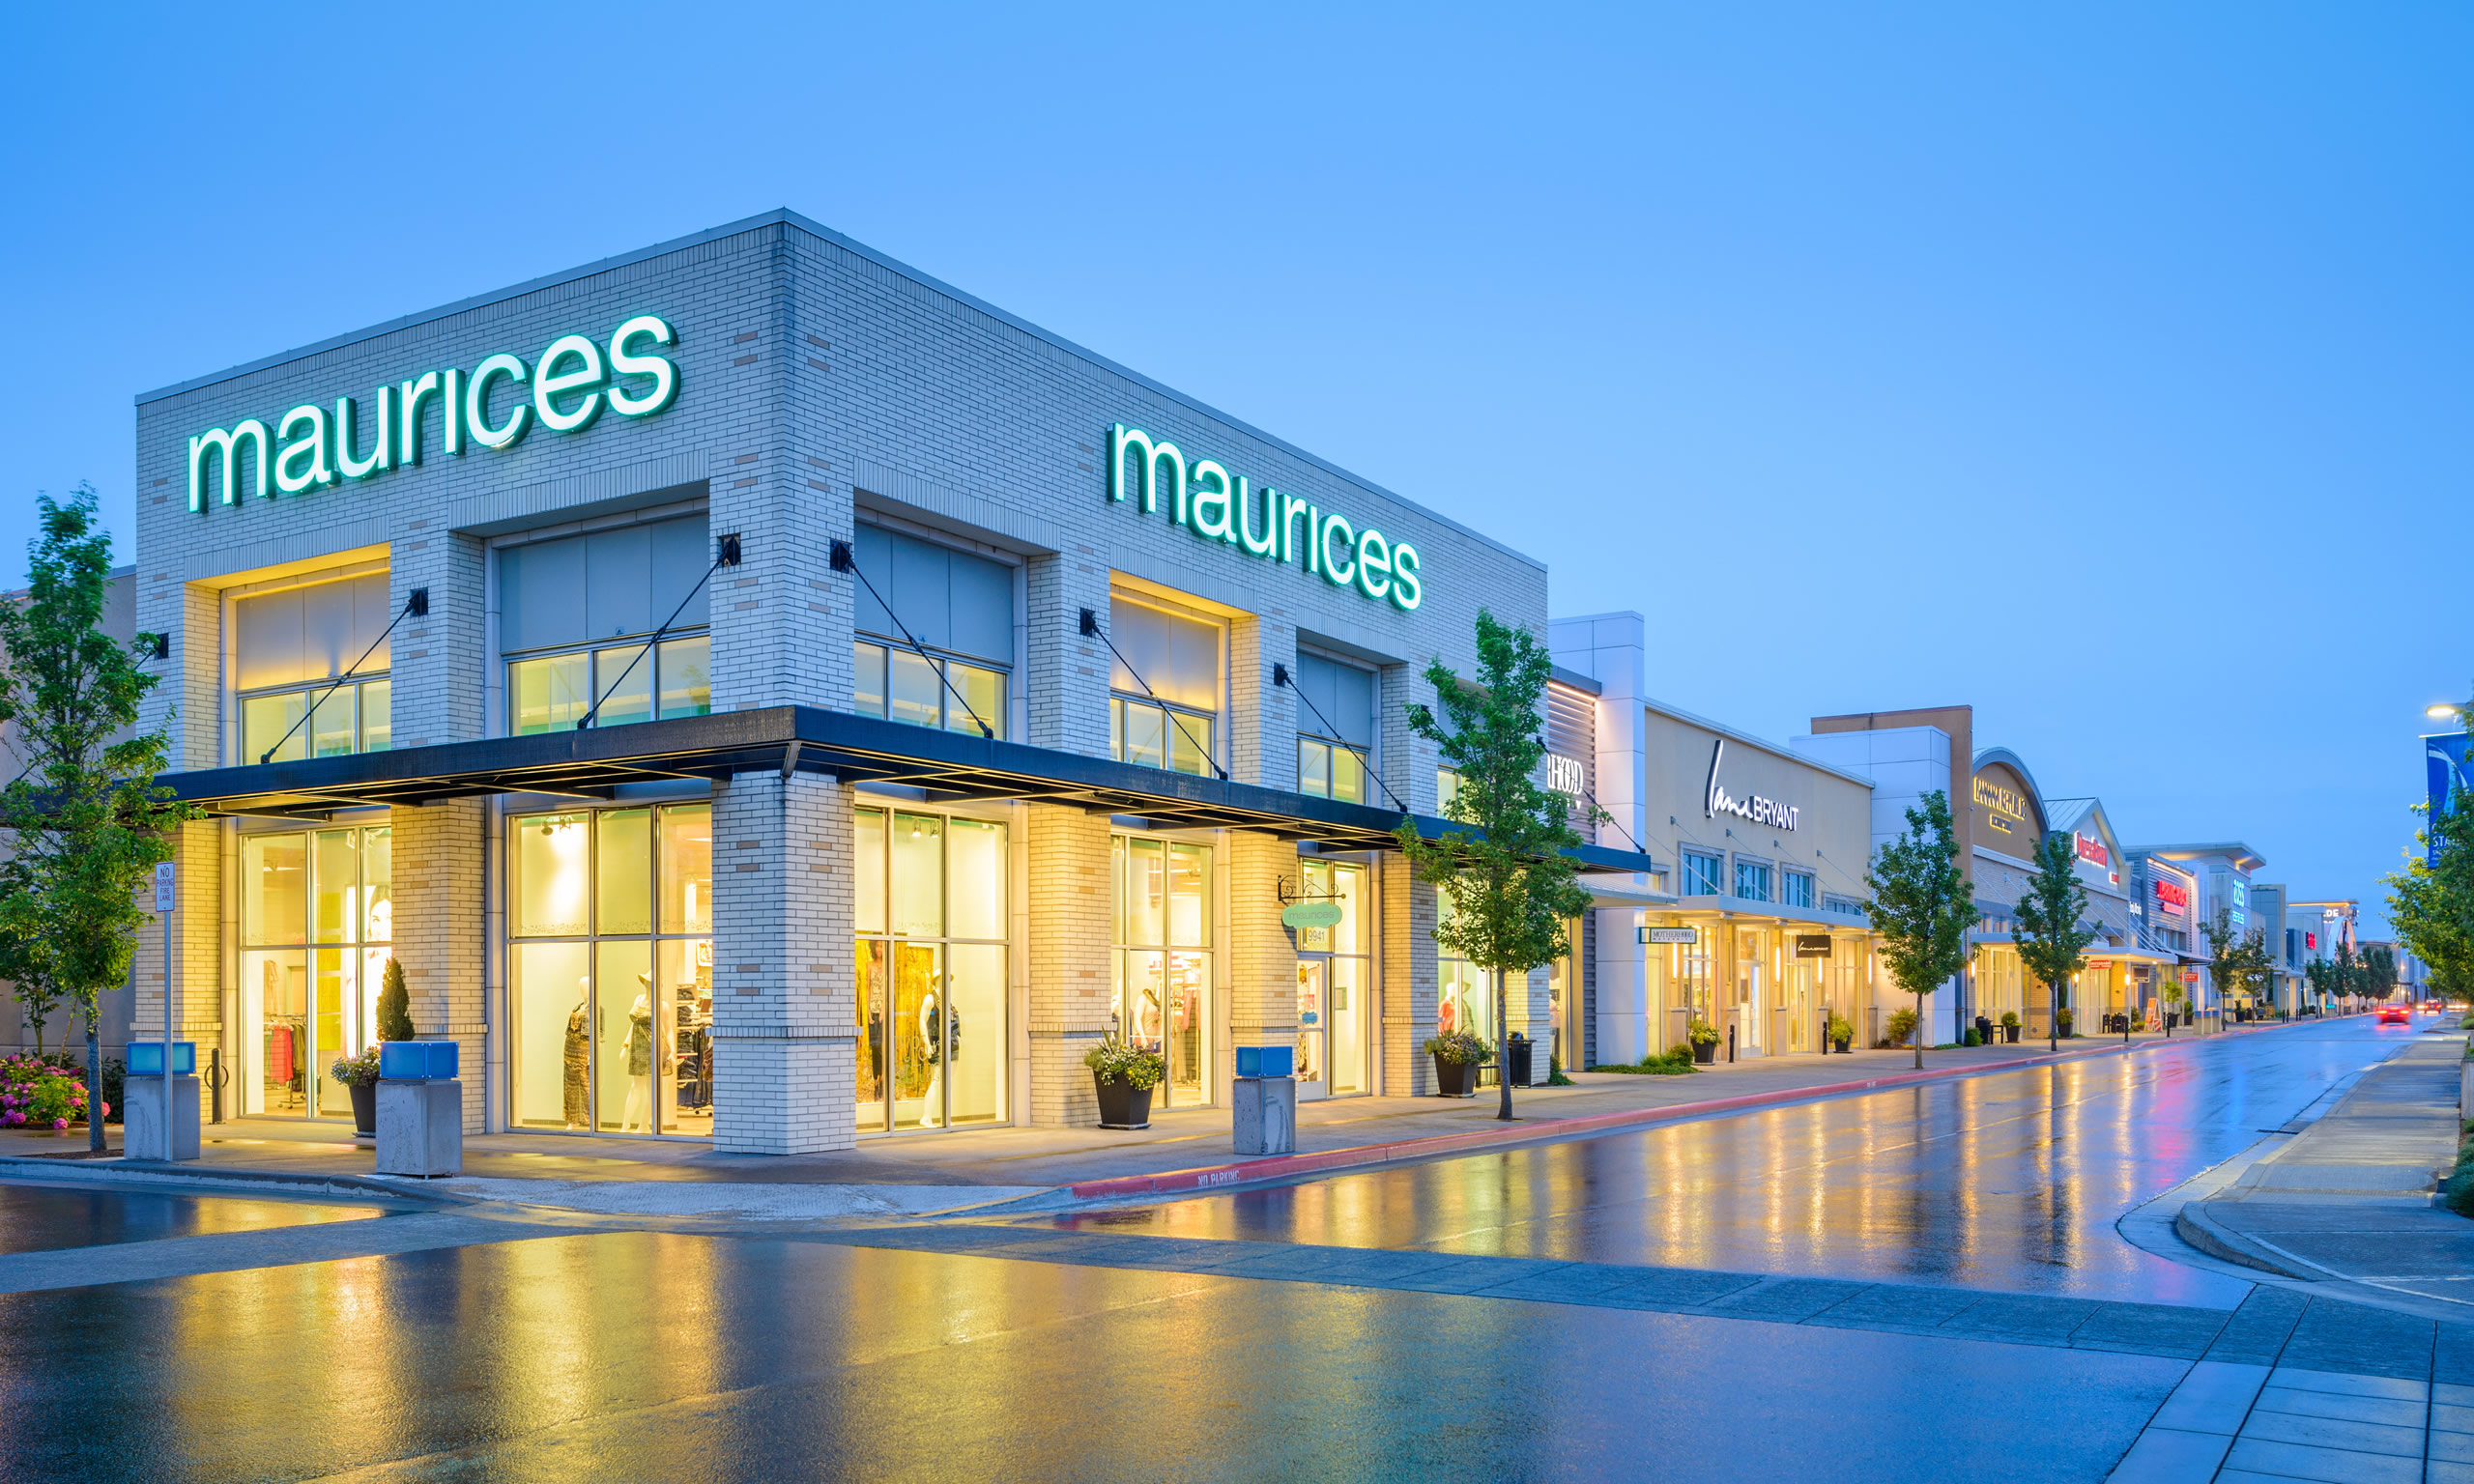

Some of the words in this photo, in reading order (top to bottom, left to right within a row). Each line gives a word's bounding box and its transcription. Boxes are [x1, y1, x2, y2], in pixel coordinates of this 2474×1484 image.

[188, 315, 680, 514] maurices
[1108, 422, 1422, 611] maurices
[1749, 795, 1798, 831] BRYANT
[160, 867, 170, 877] NO
[1288, 910, 1335, 921] maurices
[1308, 929, 1325, 942] 9941
[1198, 1174, 1208, 1187] NO
[1210, 1169, 1240, 1185] PARKING
